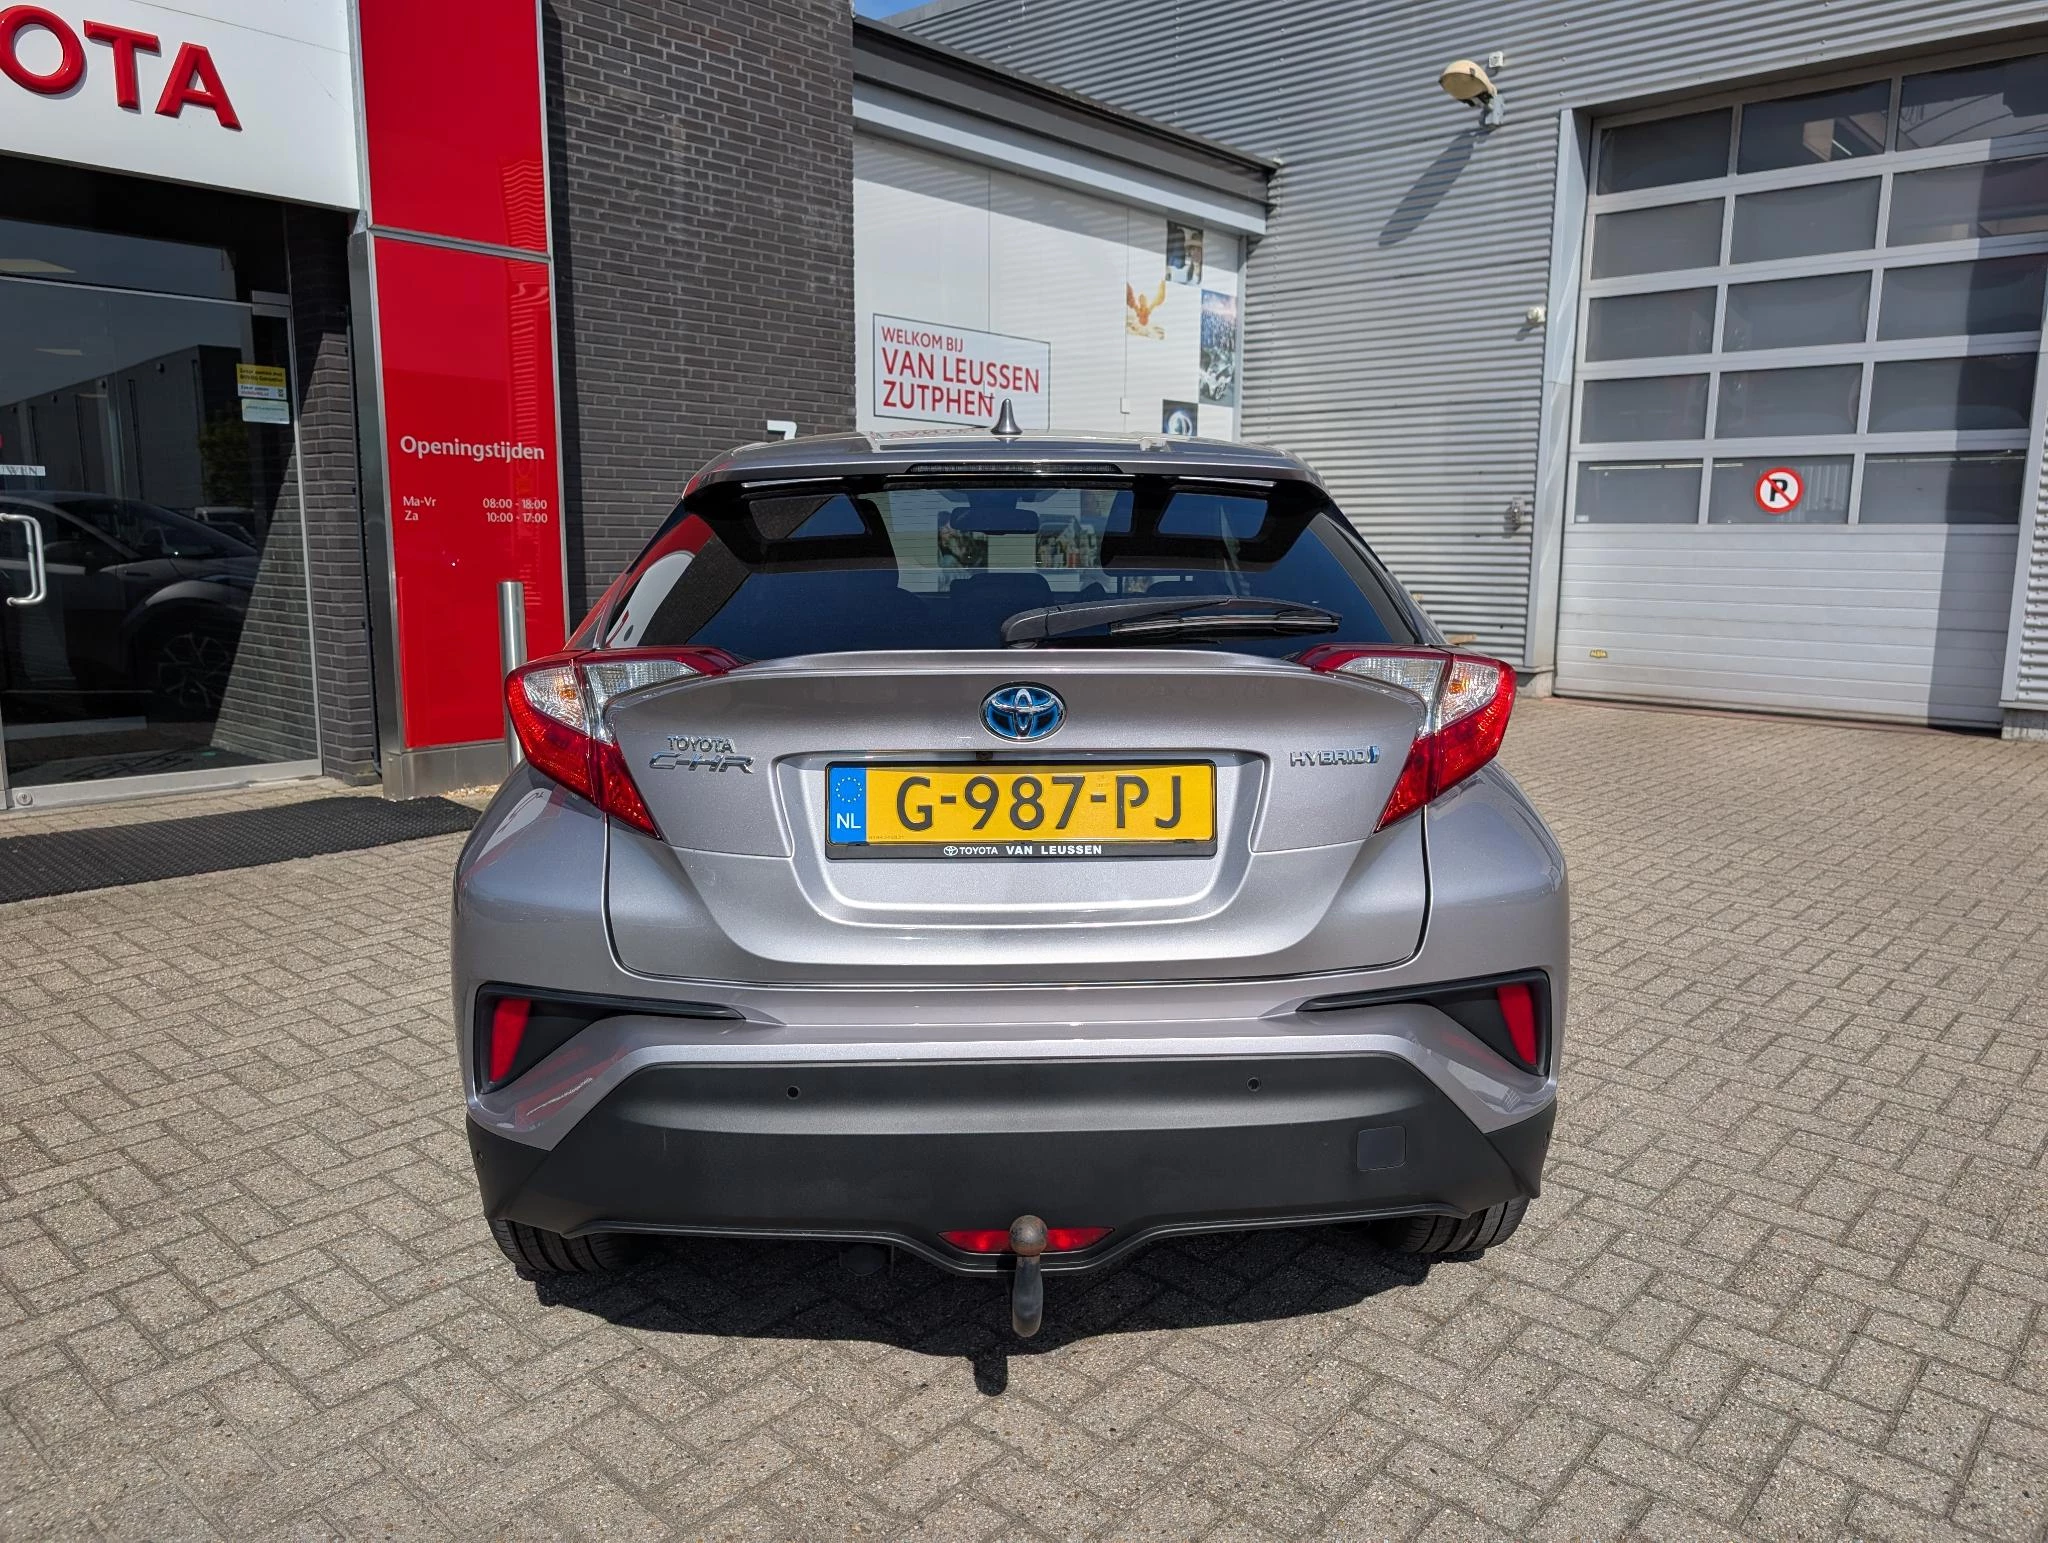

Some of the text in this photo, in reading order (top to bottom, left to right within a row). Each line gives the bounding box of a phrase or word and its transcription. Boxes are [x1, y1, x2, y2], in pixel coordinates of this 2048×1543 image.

[881, 326, 964, 353] WELKOM BIJ
[881, 346, 1040, 395] VAN LEUSSEN
[882, 379, 994, 418] ZUTPHEN
[400, 435, 545, 464] Openingstijden
[403, 495, 437, 508] Ma-Vr
[482, 497, 513, 510] 08:00
[522, 498, 548, 511] 18:00
[404, 509, 419, 522] Za
[487, 511, 514, 523] 10:00
[523, 511, 548, 524] 17:00
[667, 735, 736, 754] TOYOTA
[649, 750, 754, 775] C-HR
[1289, 748, 1367, 768] HYBRID
[896, 775, 1182, 832] G-987-PJ
[836, 812, 862, 830] NL
[959, 844, 1103, 856] TOYOTA VAN LEUSSEN
